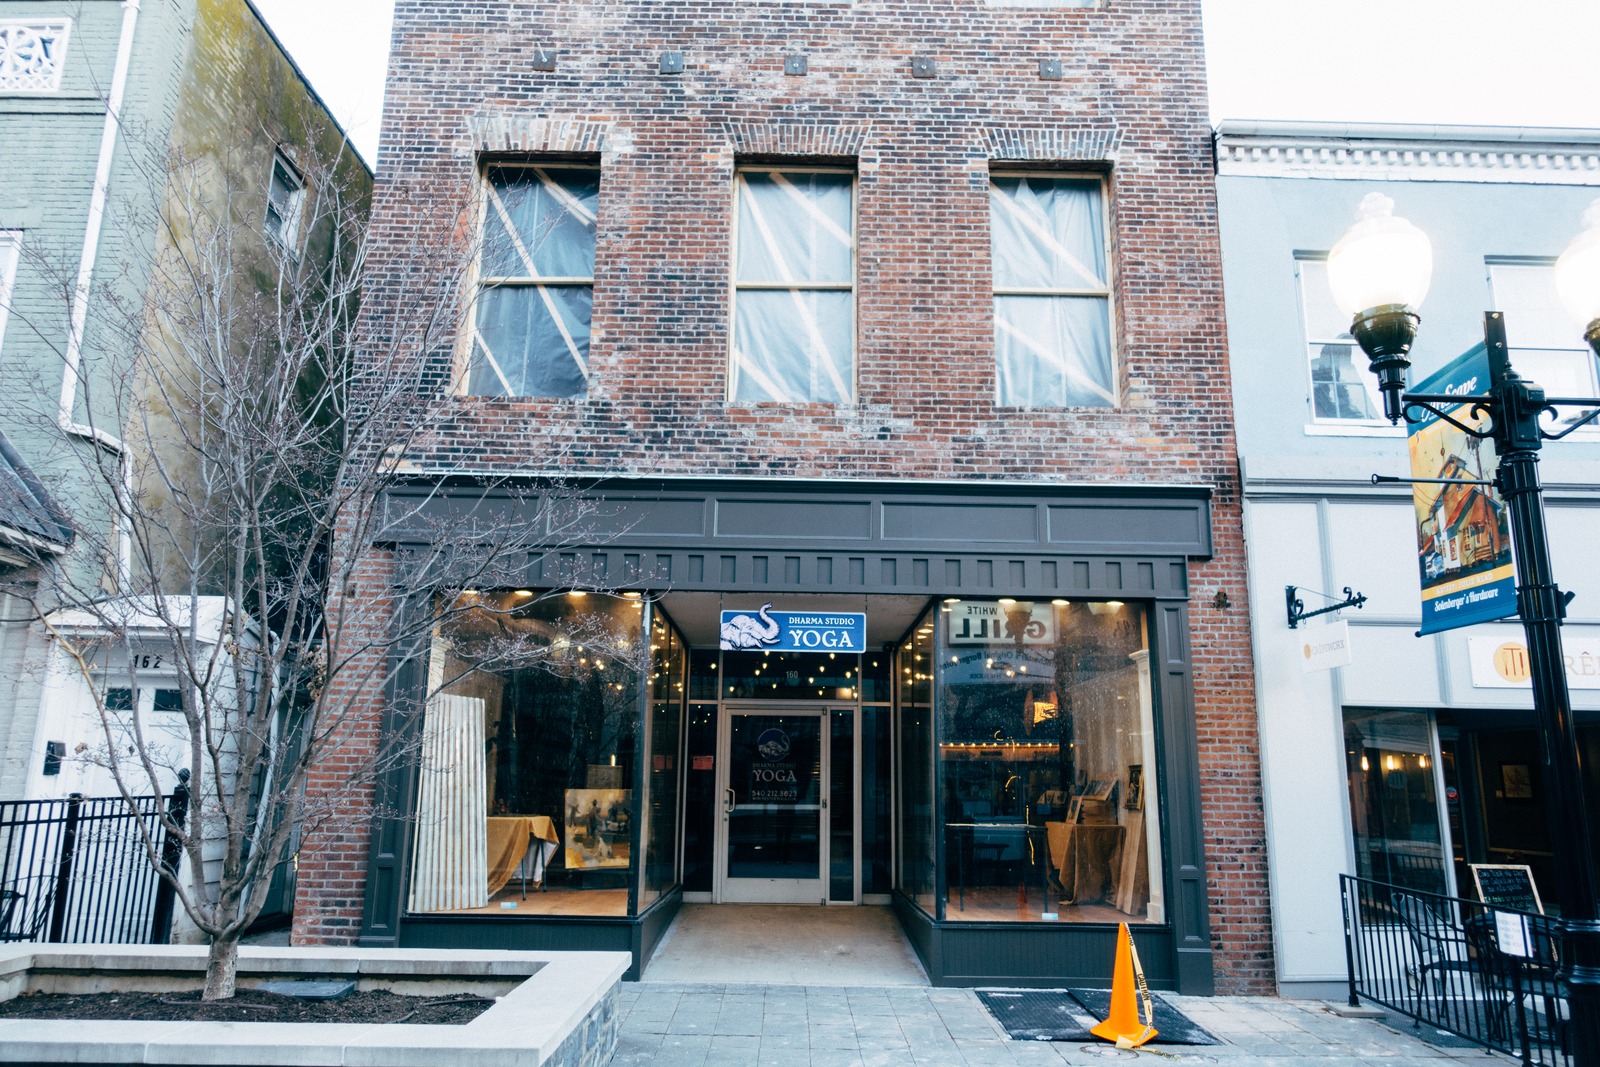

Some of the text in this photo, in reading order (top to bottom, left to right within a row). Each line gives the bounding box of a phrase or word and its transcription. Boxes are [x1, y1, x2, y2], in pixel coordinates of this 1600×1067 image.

[1469, 588, 1499, 603] Hardware
[788, 617, 855, 626] DHARMA STUDIO
[788, 630, 854, 648] YOGA
[133, 654, 163, 669] 162
[786, 671, 799, 679] 160
[752, 770, 798, 782] YOGA
[1137, 973, 1151, 1001] CAUTION
